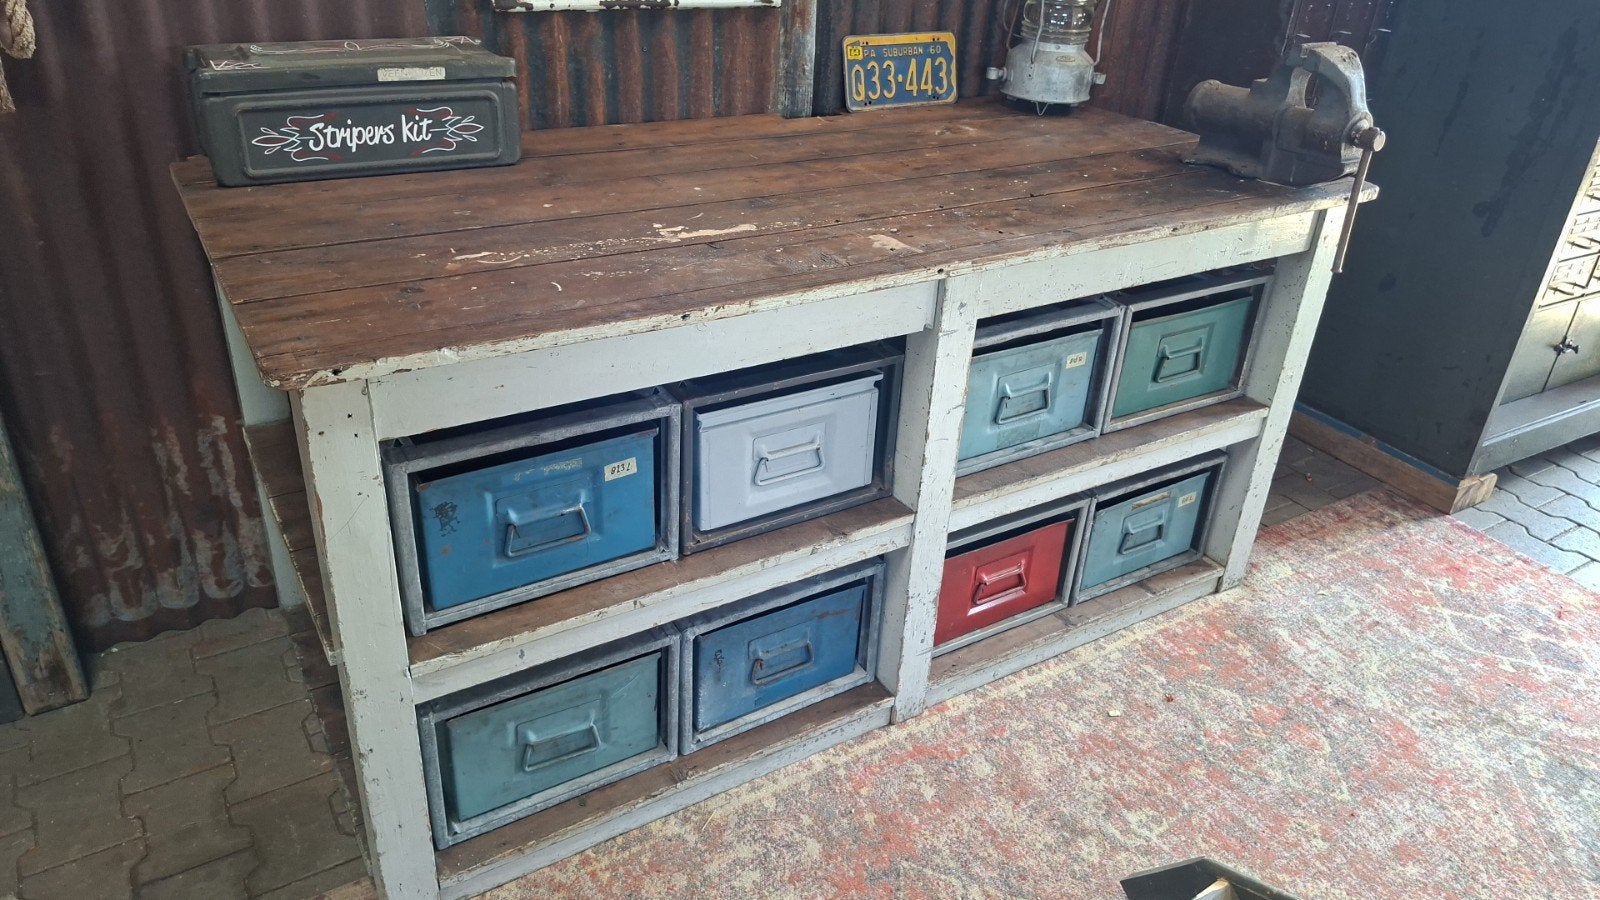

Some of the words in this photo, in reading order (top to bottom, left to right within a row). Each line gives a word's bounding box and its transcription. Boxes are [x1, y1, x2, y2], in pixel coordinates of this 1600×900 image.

[864, 49, 876, 58] PA
[883, 47, 924, 57] SUBURBAN
[930, 45, 942, 55] 60
[308, 119, 395, 153] Stripers
[401, 114, 434, 143] kit
